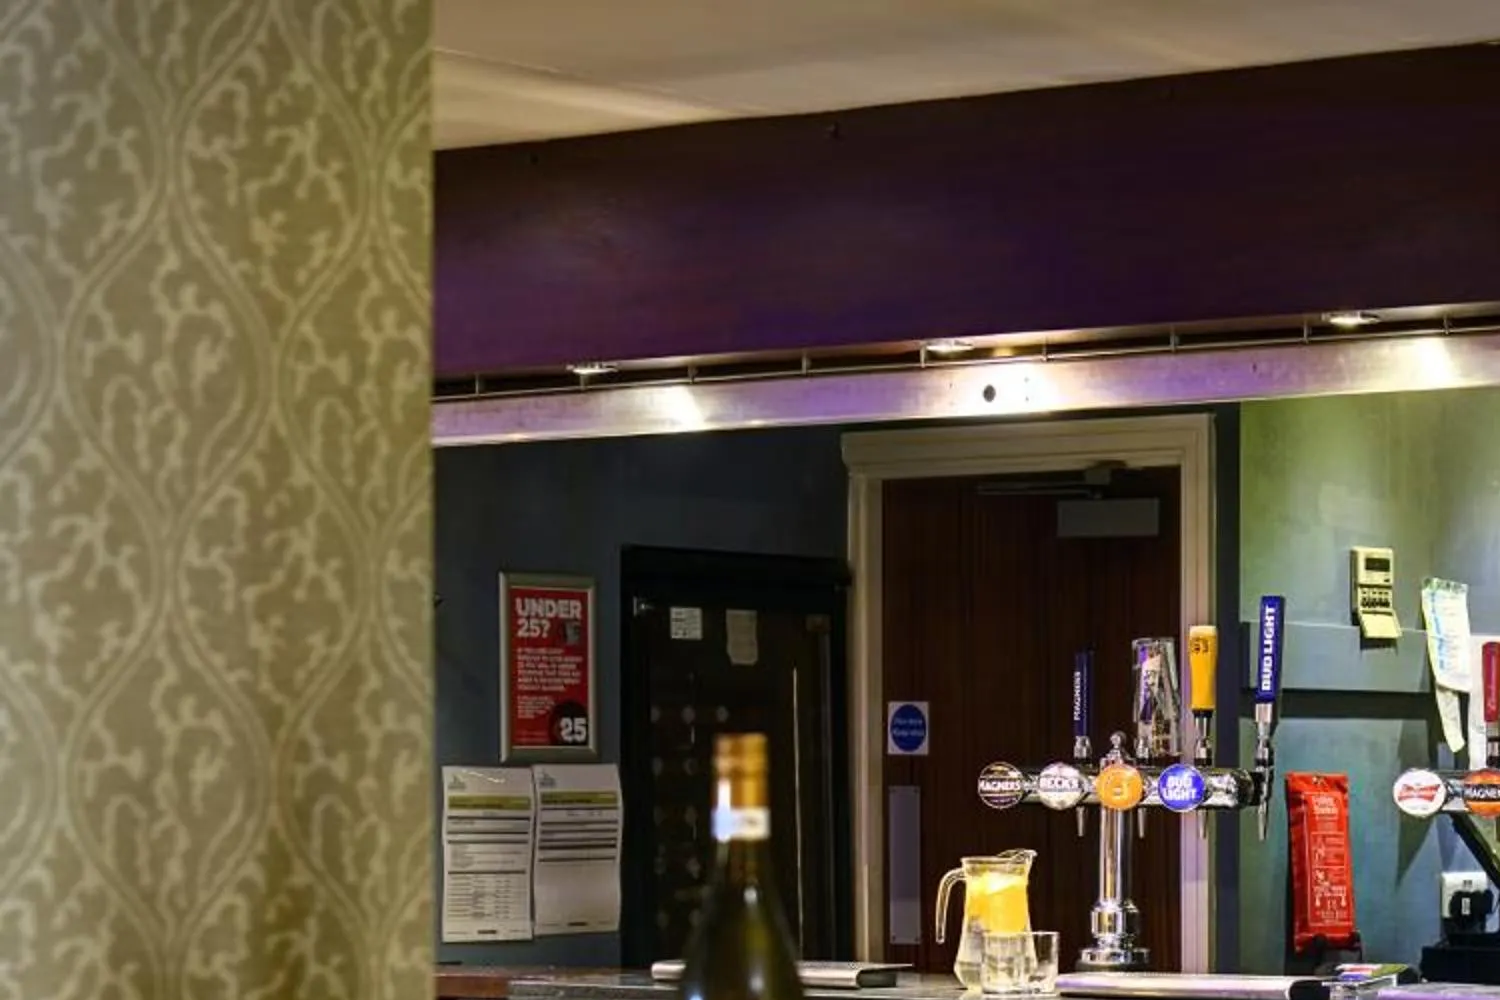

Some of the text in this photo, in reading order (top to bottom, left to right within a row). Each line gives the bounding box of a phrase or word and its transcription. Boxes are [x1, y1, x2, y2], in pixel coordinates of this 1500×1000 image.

[515, 597, 583, 619] UNDER
[516, 618, 551, 639] 25?
[1260, 605, 1277, 692] BUD LIGHT
[559, 717, 587, 744] 25
[1166, 775, 1193, 788] BUD
[1162, 787, 1197, 801] LIGHT
